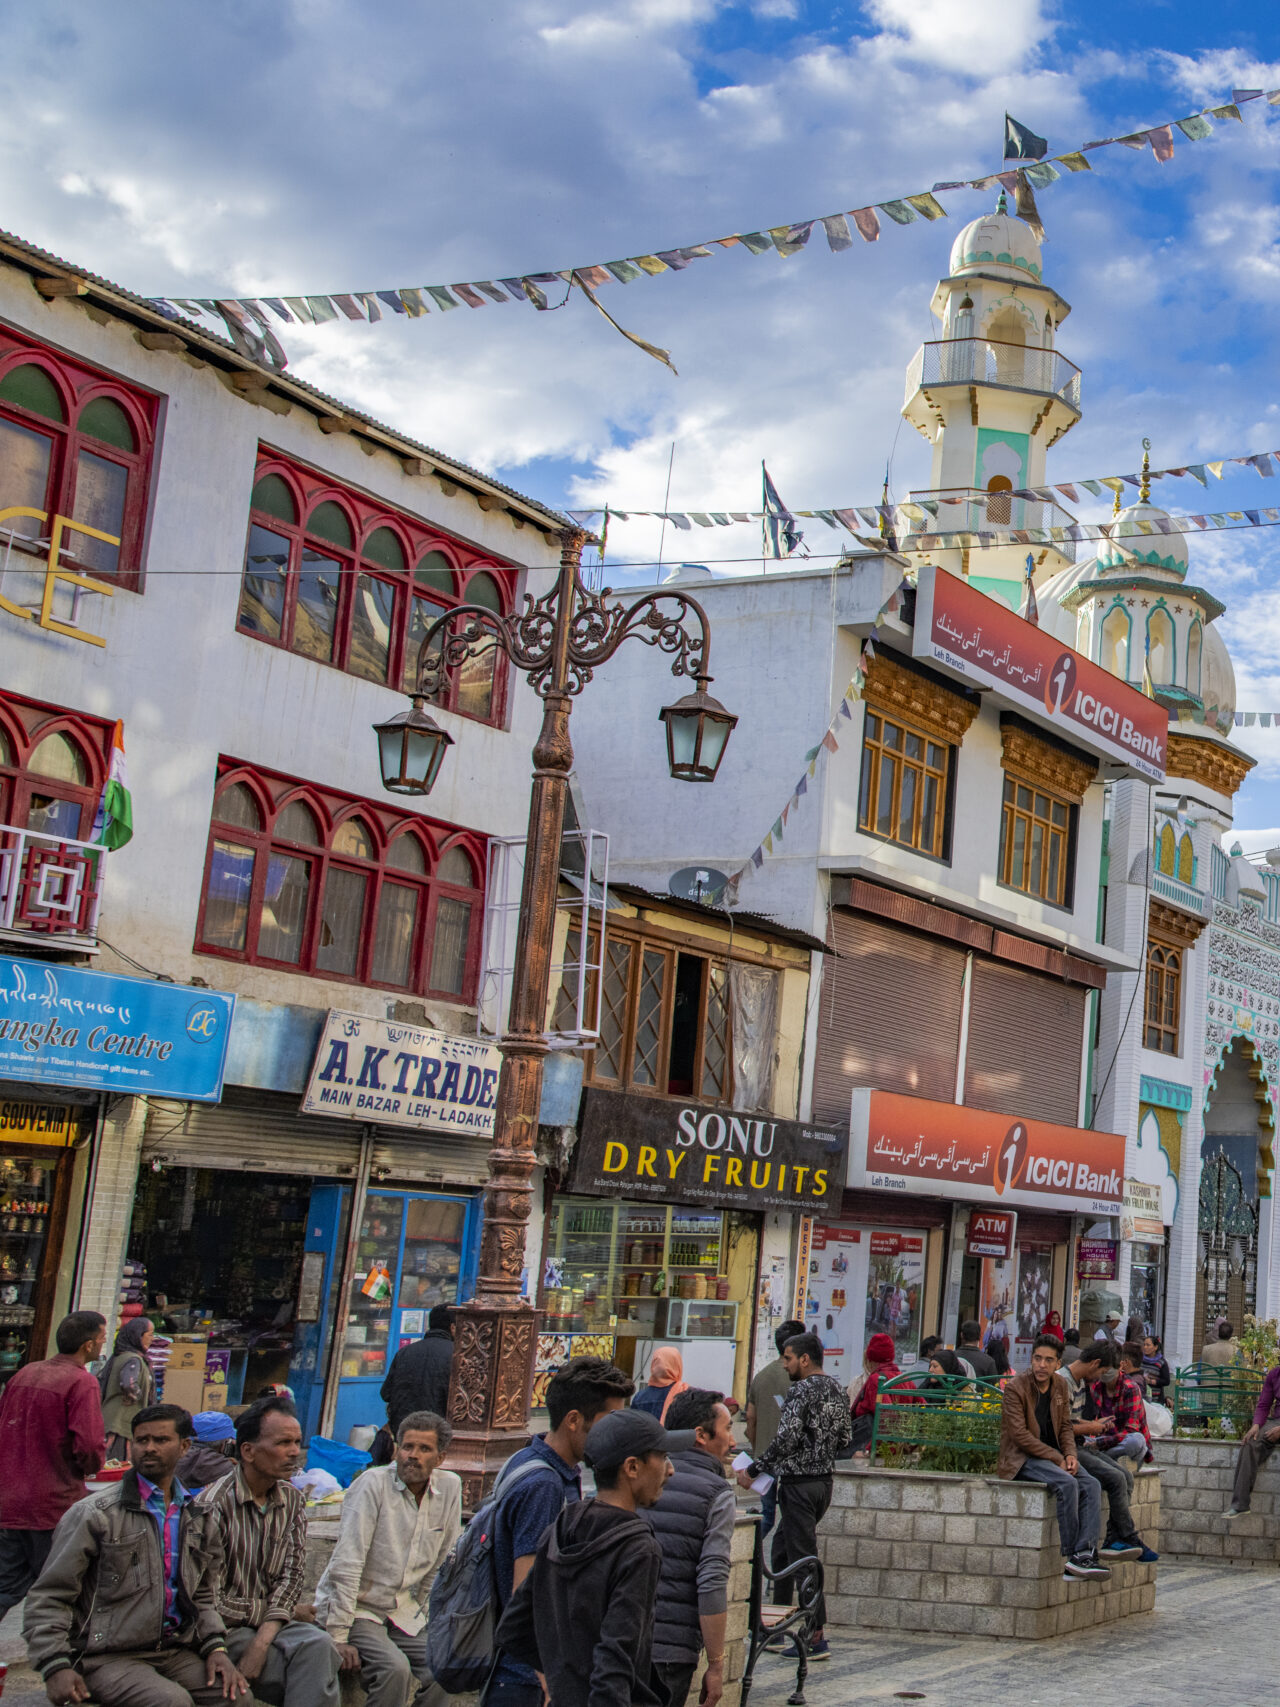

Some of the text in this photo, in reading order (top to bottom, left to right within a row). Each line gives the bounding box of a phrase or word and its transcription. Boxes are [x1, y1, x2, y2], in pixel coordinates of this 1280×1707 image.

[934, 647, 965, 672] Leh Branch
[1074, 690, 1164, 763] ICICI Bank
[1152, 766, 1163, 780] ATM
[187, 1009, 217, 1036] LTC
[87, 1026, 173, 1061] Centre
[10, 1051, 34, 1062] Shawls
[36, 1056, 49, 1064] and
[50, 1056, 75, 1067] Tibetan
[76, 1060, 109, 1071] Handicraft
[109, 1065, 121, 1073] gift
[121, 1066, 138, 1075] items
[391, 1051, 498, 1111] TRADE
[319, 1087, 353, 1106] MAIN
[356, 1094, 402, 1114] BAZAR
[0, 1102, 66, 1134] SOUVENIR
[676, 1109, 778, 1158] SONU
[603, 1141, 828, 1196] DRY FRUITS
[871, 1174, 906, 1189] Leh Branch
[1025, 1155, 1122, 1196] ICICI Bank
[1092, 1201, 1120, 1213] 24 Hour ATM
[974, 1217, 1007, 1233] ATM
[797, 1222, 809, 1320] BEST FORE
